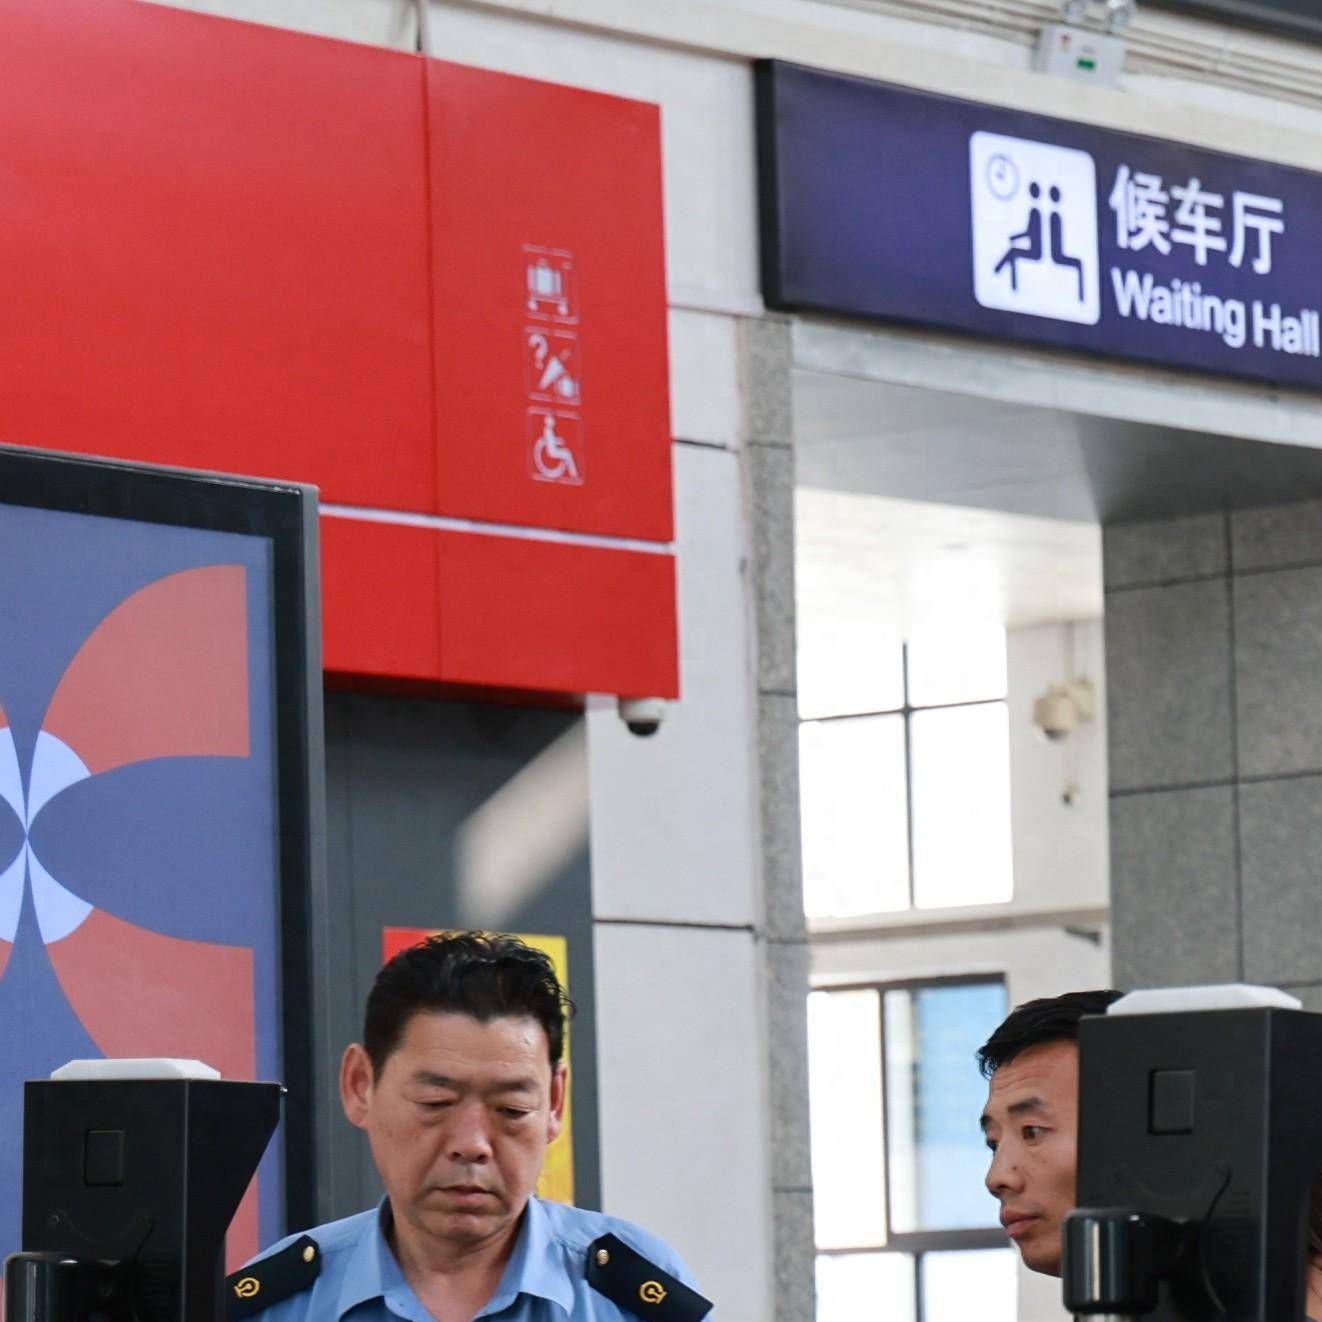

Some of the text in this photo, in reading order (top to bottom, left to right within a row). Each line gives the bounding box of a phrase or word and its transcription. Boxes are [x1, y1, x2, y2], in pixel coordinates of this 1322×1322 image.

[1109, 164, 1285, 274] 候车厅
[1110, 266, 1320, 357] Waiting Hall
